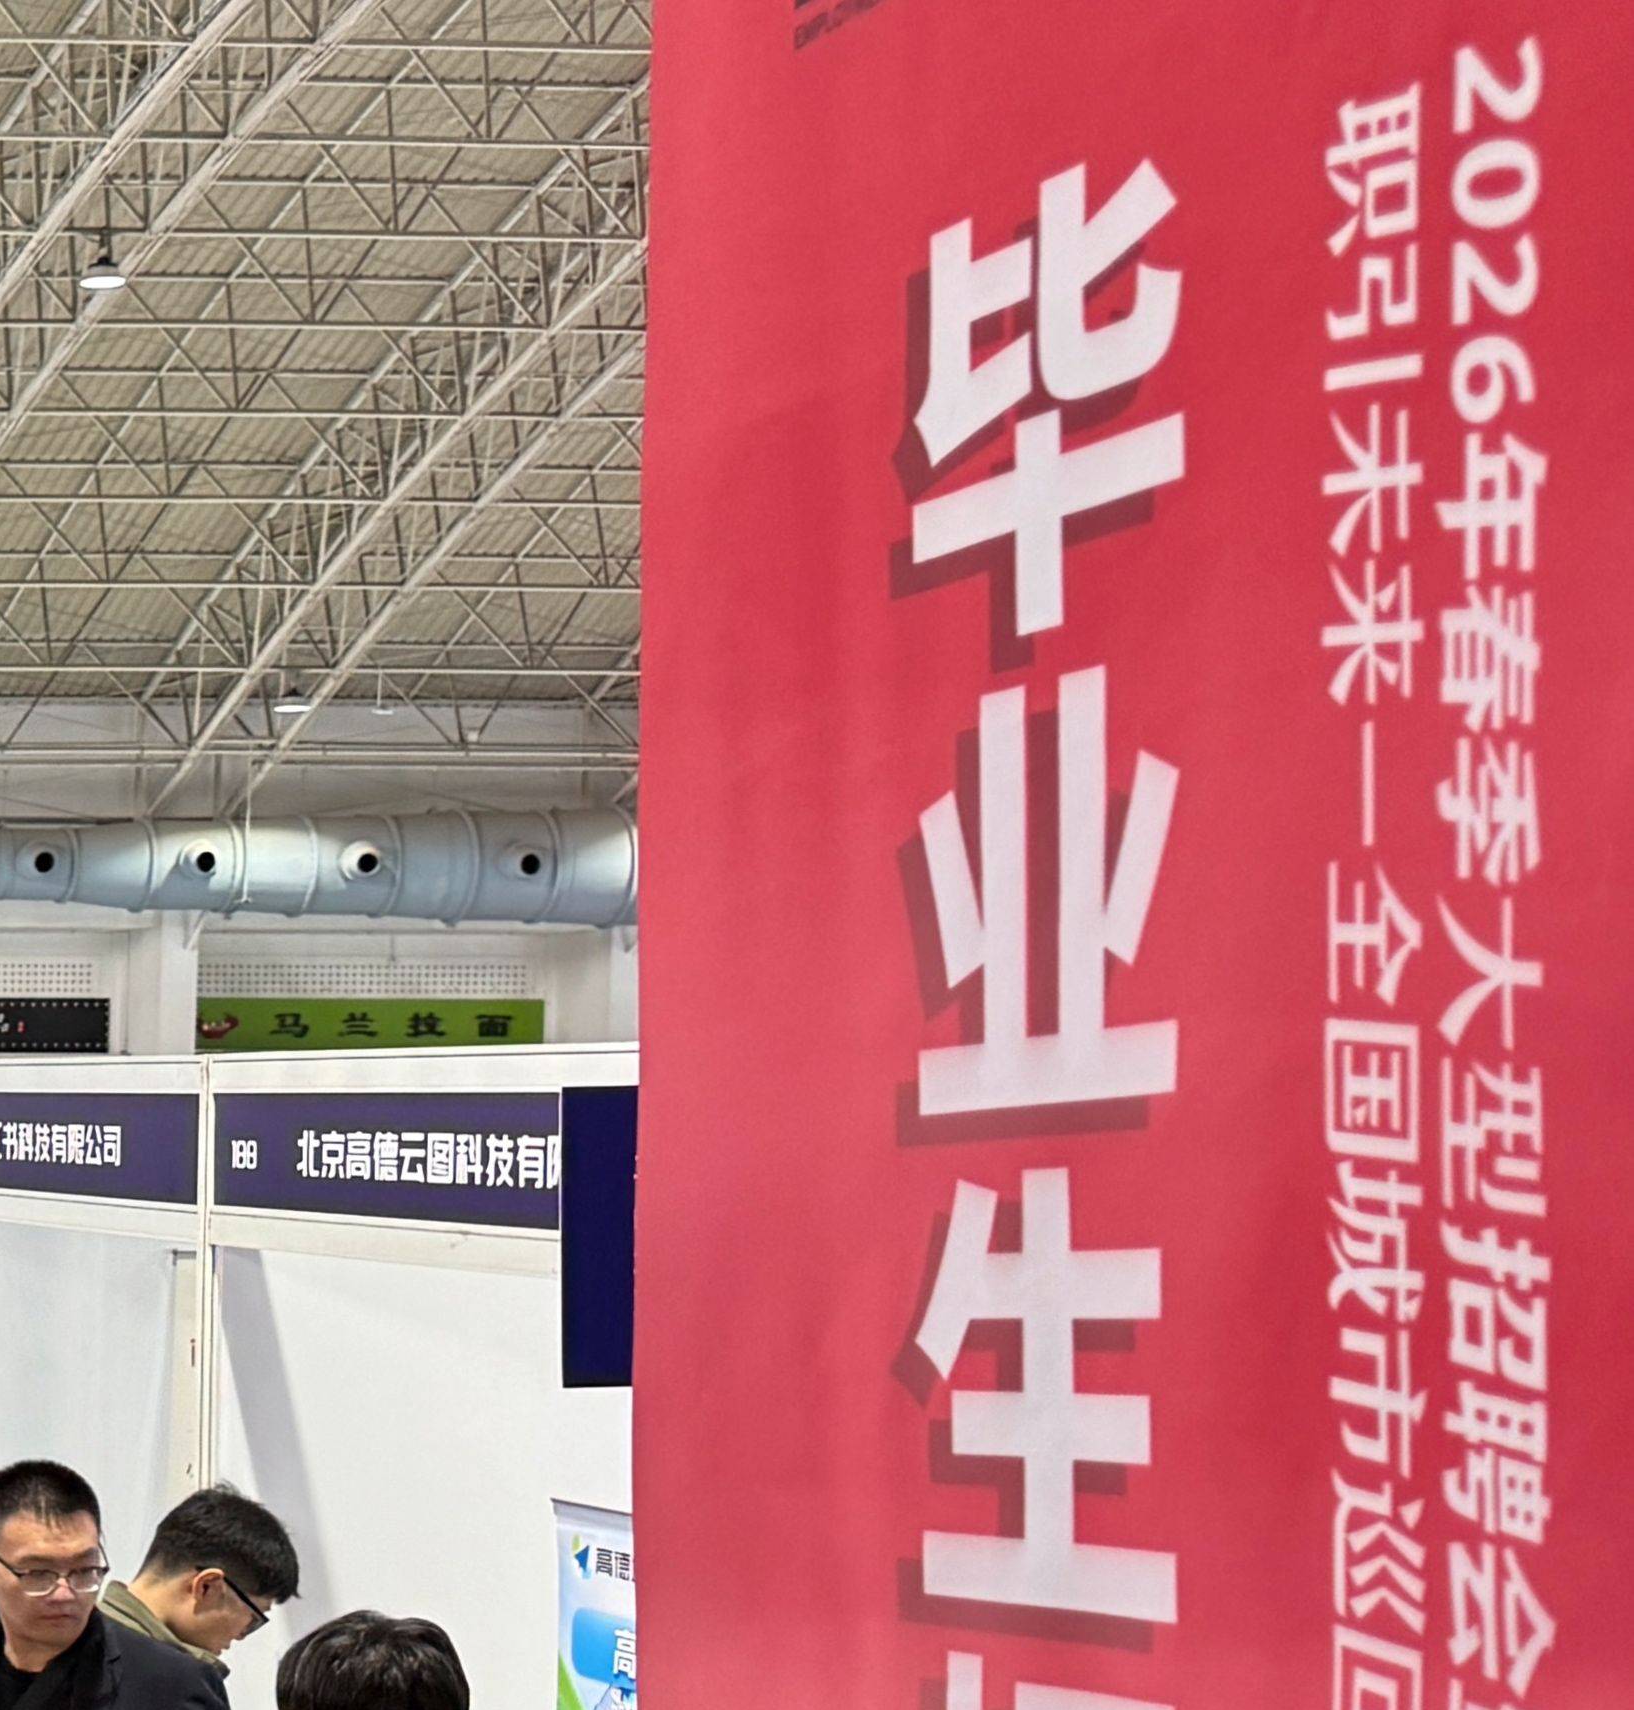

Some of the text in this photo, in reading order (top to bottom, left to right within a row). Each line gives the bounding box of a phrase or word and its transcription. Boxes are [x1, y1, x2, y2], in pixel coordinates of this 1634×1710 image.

[269, 1011, 514, 1038] 马兰拉面
[231, 1139, 258, 1170] 188
